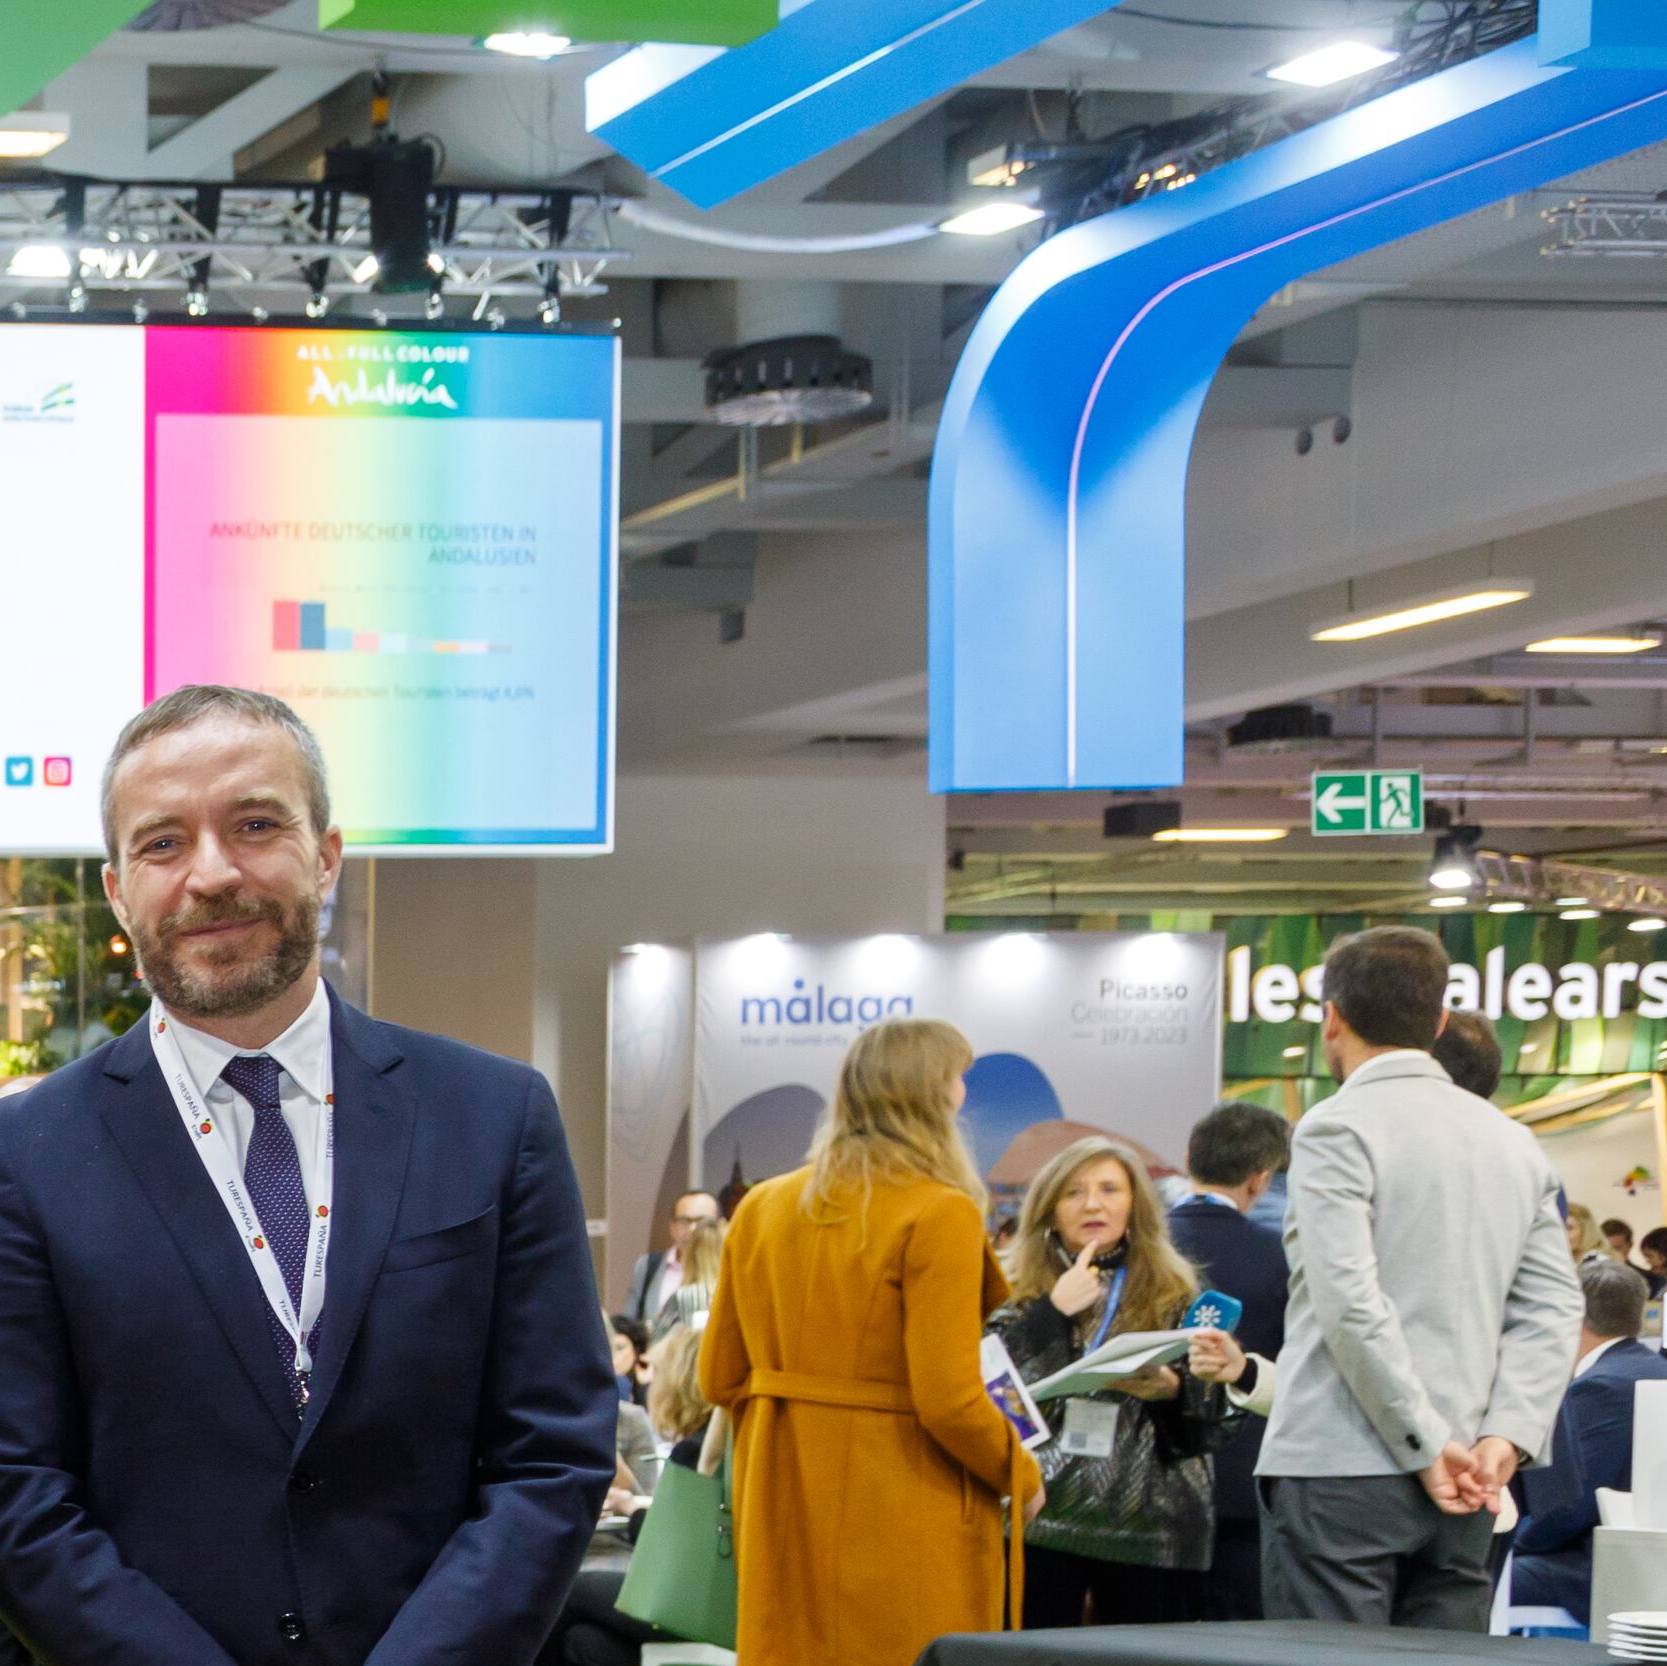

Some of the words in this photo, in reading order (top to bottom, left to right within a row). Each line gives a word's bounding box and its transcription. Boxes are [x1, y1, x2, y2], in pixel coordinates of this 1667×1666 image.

[346, 344, 395, 363] FULL
[396, 345, 470, 364] COLOUR
[306, 366, 459, 410] Andalucía
[209, 518, 301, 540] ANKÜNFTE
[308, 522, 412, 541] DEUTSCHER
[419, 522, 514, 542] TOURISTEN
[519, 523, 537, 542] IN
[427, 546, 537, 566] ANDALUSIEN
[1100, 979, 1188, 1000] Picasso
[1443, 945, 1667, 1021] alears
[226, 1180, 254, 1232] TURESPAÑA
[313, 1224, 328, 1279] TURESPAÑA
